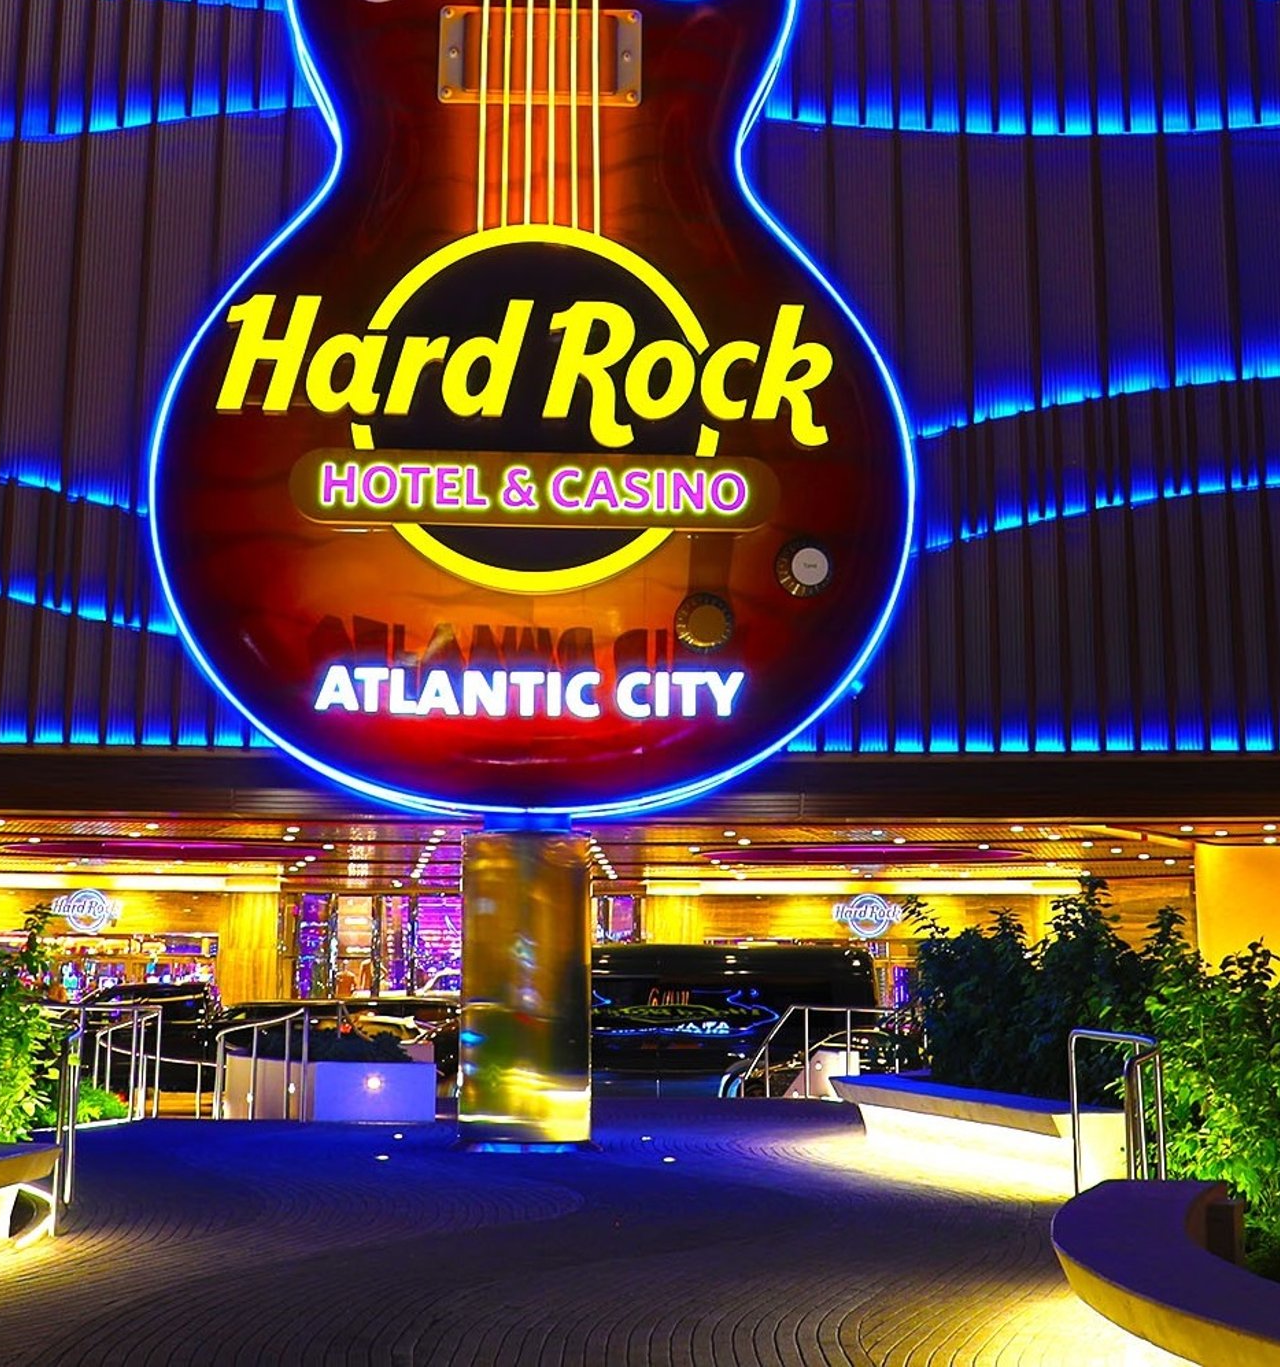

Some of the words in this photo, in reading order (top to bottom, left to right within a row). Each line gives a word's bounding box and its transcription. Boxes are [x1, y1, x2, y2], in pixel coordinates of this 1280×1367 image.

[215, 294, 535, 417] Hard
[541, 300, 834, 449] Rock
[320, 463, 489, 509] HOTEL
[501, 467, 538, 509] &
[550, 468, 748, 514] CASINO
[314, 665, 600, 719] ATLANTIC
[616, 671, 745, 718] CITY
[51, 897, 86, 914] Hard
[834, 903, 868, 919] Hard
[870, 904, 901, 923] Rock
